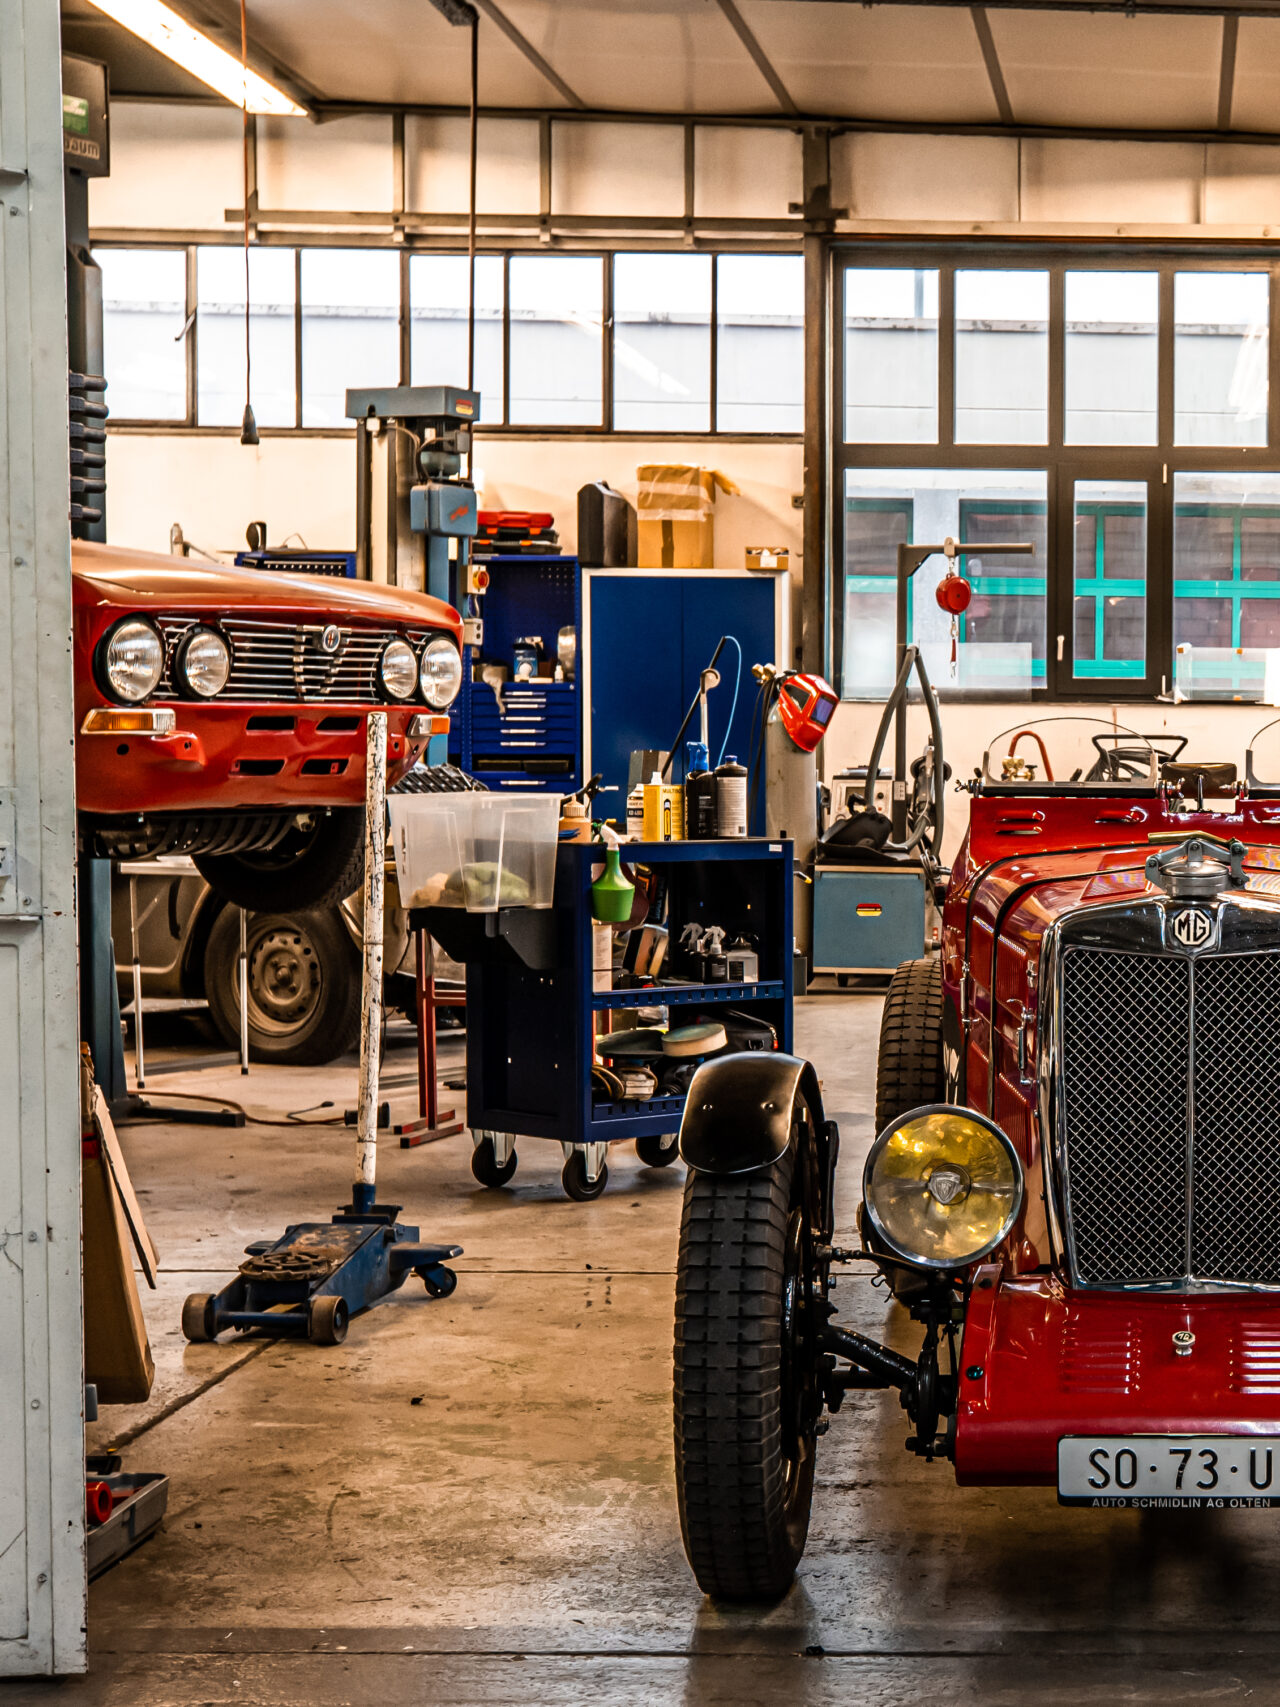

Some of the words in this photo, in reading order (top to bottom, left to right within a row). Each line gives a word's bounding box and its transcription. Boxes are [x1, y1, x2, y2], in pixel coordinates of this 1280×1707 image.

[1177, 912, 1207, 942] MG
[1092, 1498, 1127, 1508] AUTO
[1131, 1498, 1201, 1508] SCHMIDLIN
[1206, 1498, 1224, 1508] AG
[1229, 1498, 1271, 1508] OLTEN
